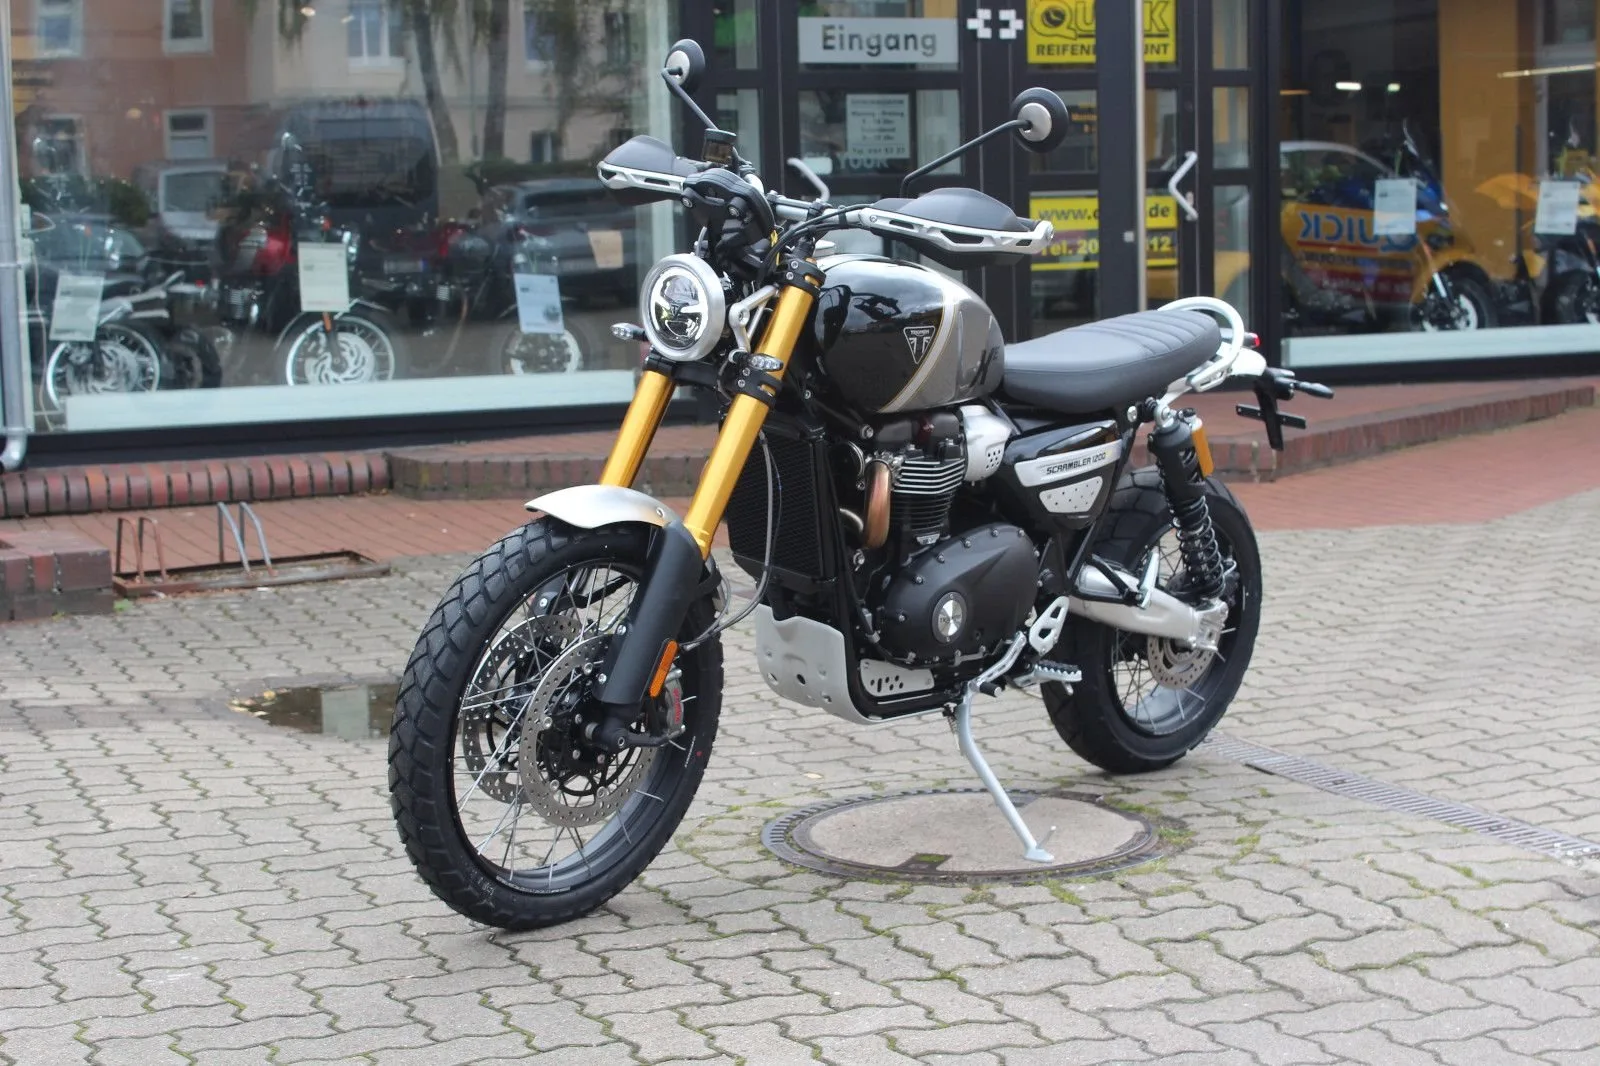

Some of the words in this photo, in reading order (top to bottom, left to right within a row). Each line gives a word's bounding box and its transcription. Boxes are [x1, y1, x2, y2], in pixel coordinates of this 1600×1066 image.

[821, 24, 937, 57] Eingang
[1046, 457, 1091, 475] SCRAMBLER
[1092, 452, 1107, 465] 1200
